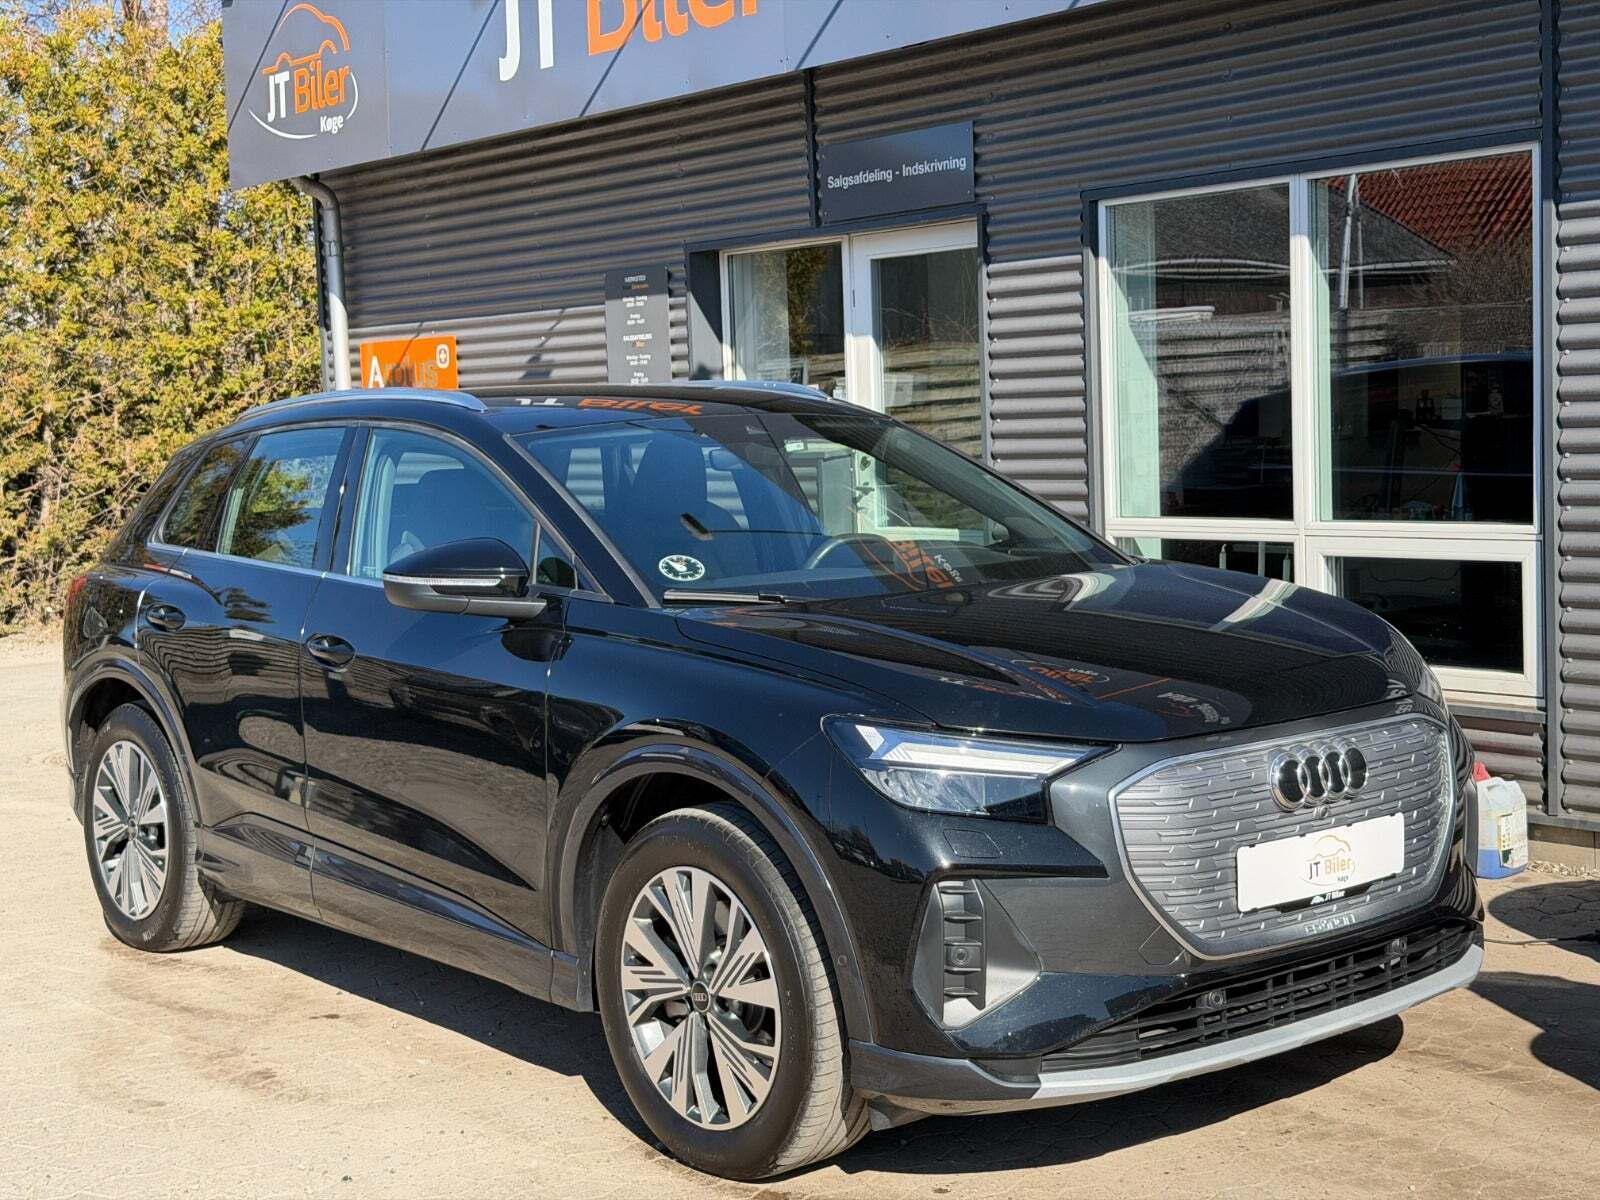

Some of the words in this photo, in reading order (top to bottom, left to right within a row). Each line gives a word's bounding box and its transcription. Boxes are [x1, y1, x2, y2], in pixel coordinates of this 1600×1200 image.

[267, 71, 290, 122] JT
[294, 60, 350, 114] Biler
[320, 115, 344, 134] Køge
[827, 168, 893, 189] Salgsafdeling
[902, 156, 967, 177] Indskrivning
[1309, 861, 1321, 880] JT
[1324, 856, 1353, 875] Biler
